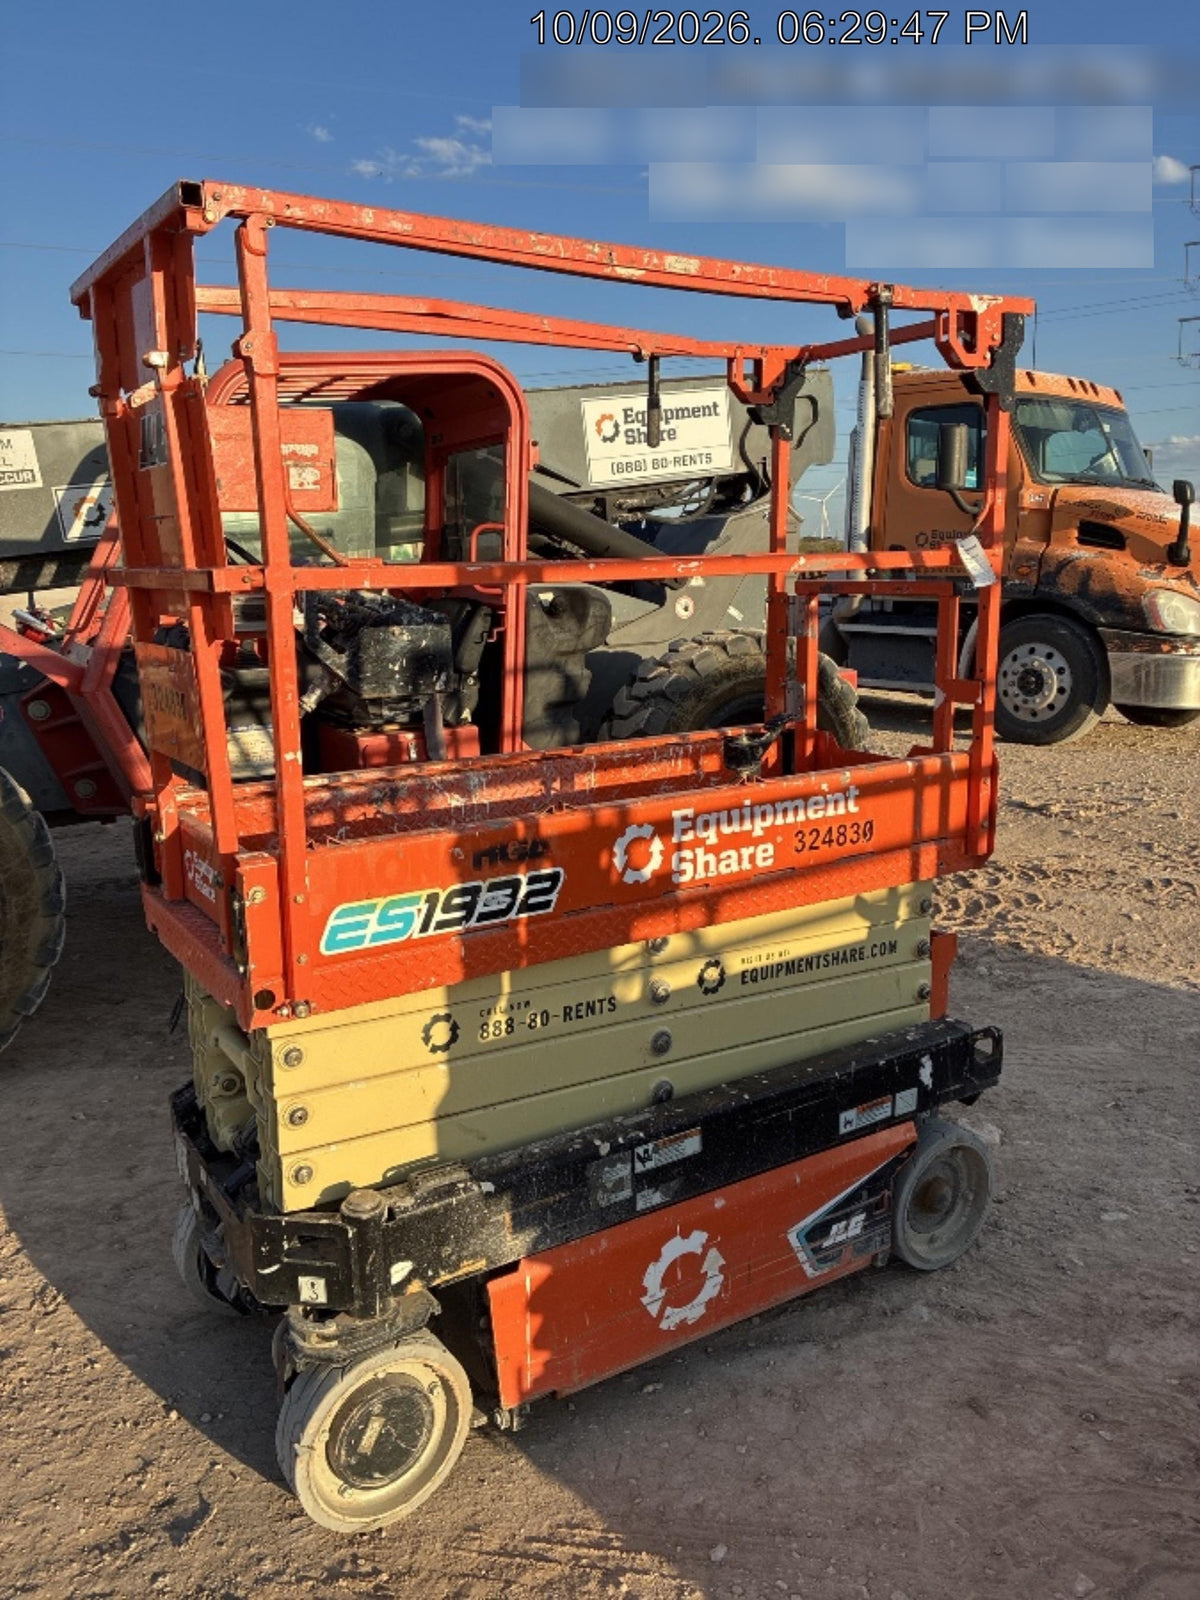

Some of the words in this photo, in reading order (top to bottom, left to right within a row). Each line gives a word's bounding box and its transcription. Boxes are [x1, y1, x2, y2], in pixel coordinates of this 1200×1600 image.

[622, 401, 720, 427] Eqpment
[624, 427, 677, 445] Shre
[672, 785, 859, 845] Equipment
[794, 819, 874, 853] 324830
[671, 841, 774, 883] Share
[321, 868, 564, 954] ES1932
[741, 940, 898, 985] EQUIPMENTSHARE.COM
[479, 995, 617, 1041] 888-80-RENTS
